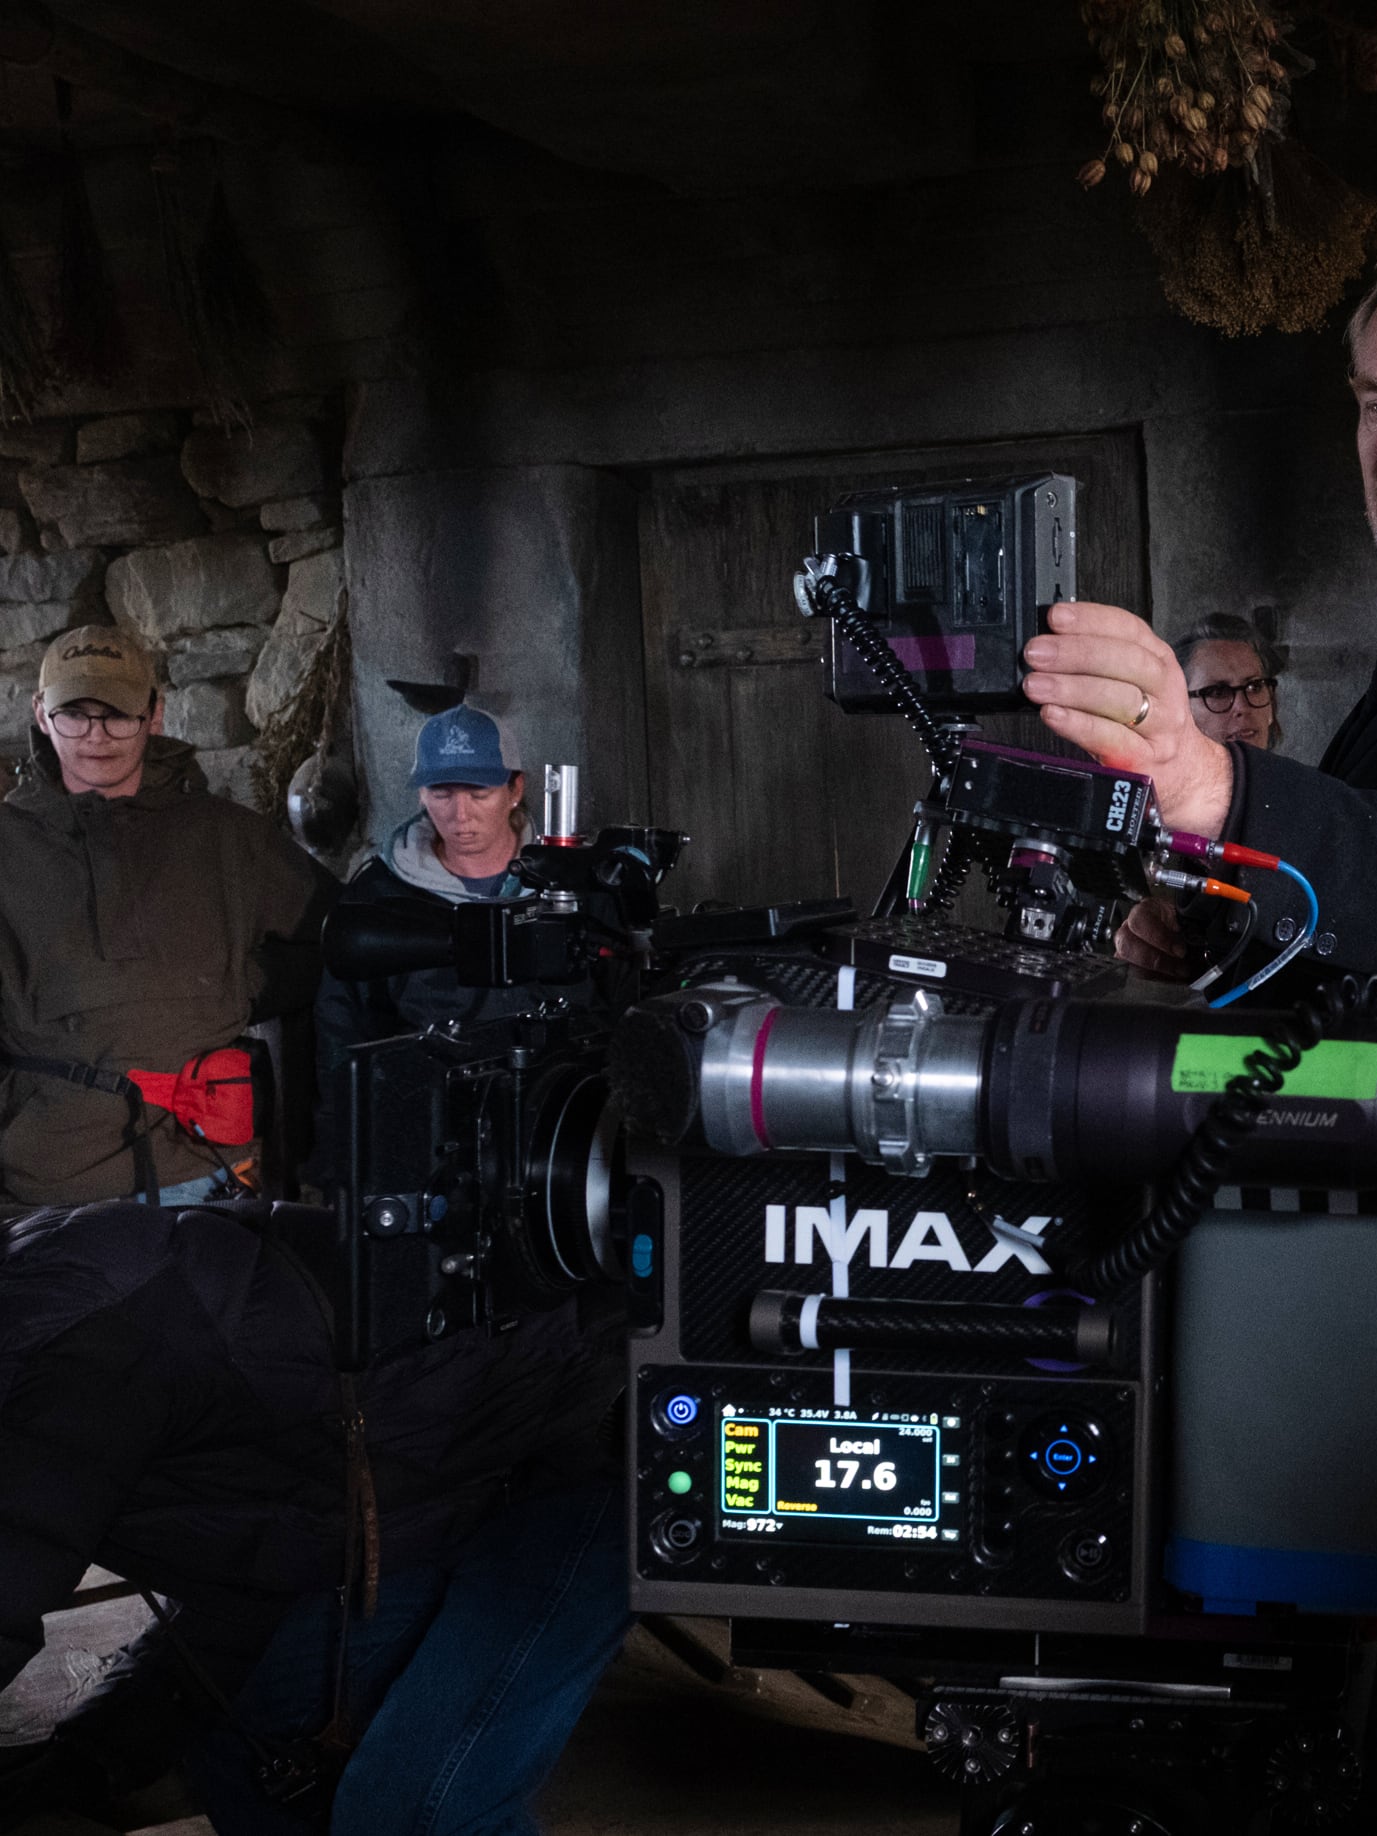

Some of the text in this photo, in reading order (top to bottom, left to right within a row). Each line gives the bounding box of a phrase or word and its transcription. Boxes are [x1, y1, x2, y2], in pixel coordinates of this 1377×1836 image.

[1105, 779, 1131, 832] CH:23
[1255, 1110, 1339, 1128] ENNIUM
[764, 1204, 1054, 1275] IMAX
[725, 1422, 759, 1437] Cam
[725, 1440, 756, 1454] Pwr
[830, 1437, 881, 1455] Local
[725, 1458, 763, 1474] Sync
[814, 1459, 897, 1491] 17.6
[725, 1475, 760, 1493] Mag
[725, 1493, 755, 1508] Vac
